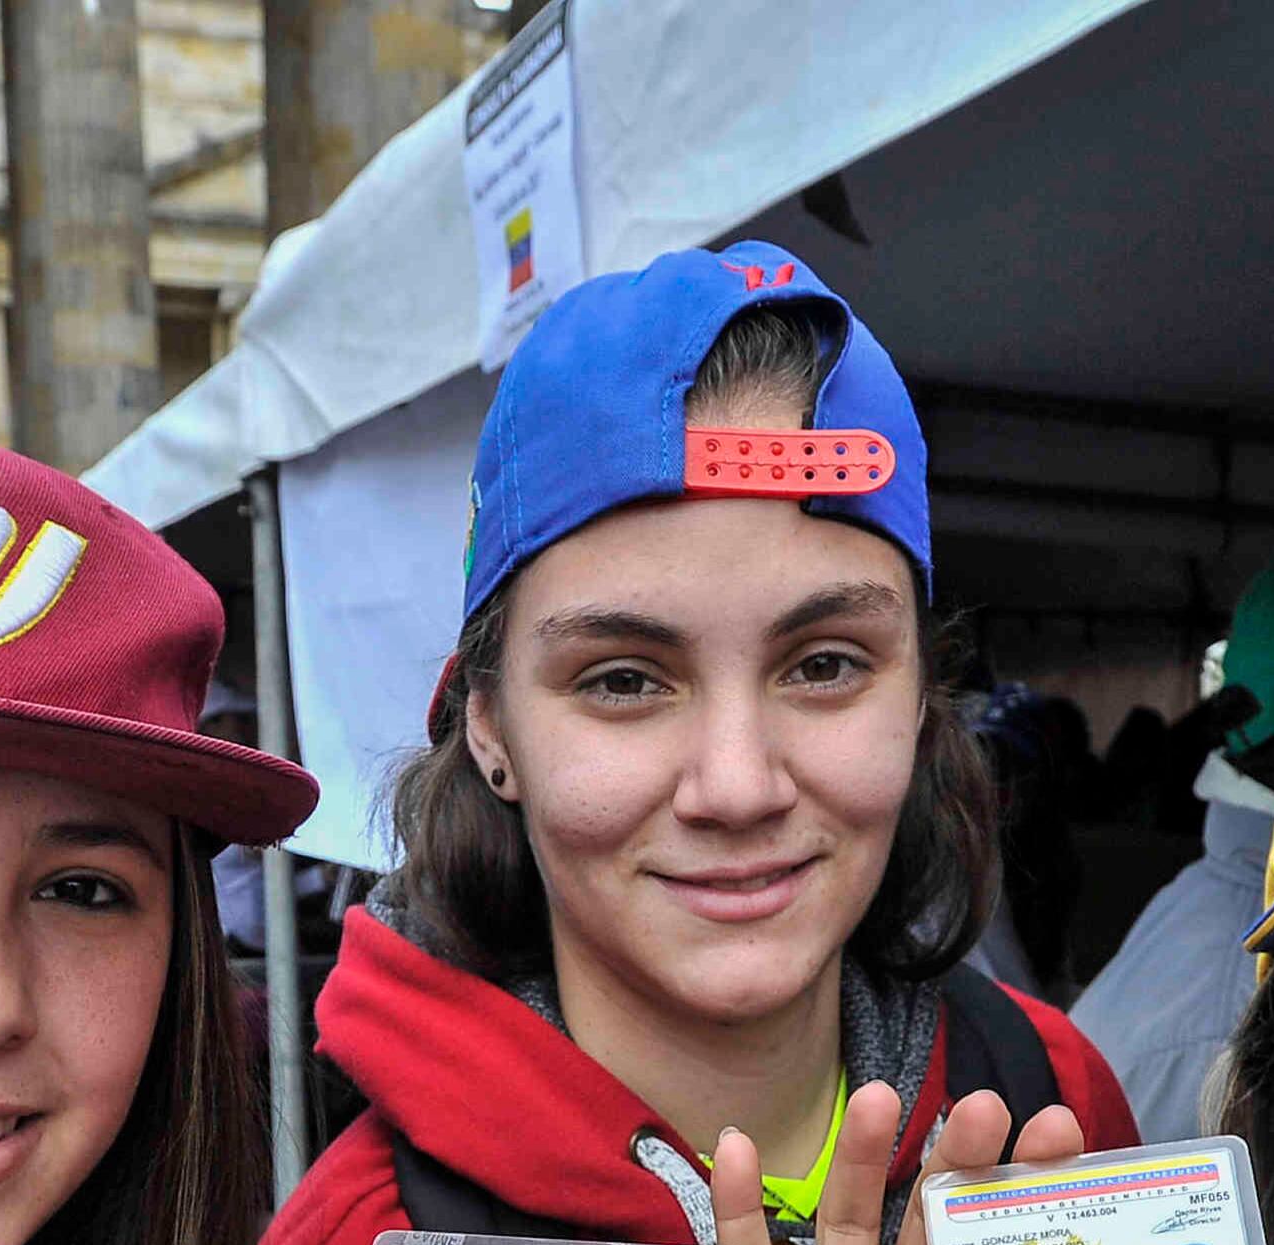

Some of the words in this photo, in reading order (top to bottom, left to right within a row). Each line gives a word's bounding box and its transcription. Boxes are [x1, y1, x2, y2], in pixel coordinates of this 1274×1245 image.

[957, 1189, 1026, 1204] REPUBLICA
[1030, 1177, 1115, 1195] BOLIVARIANA
[1117, 1175, 1133, 1184] DE
[1137, 1166, 1209, 1181] VENEZUELA
[979, 1205, 1047, 1219] CEDULA
[1059, 1200, 1076, 1208] DE
[1089, 1186, 1189, 1204] IDENTIDAD
[1189, 1191, 1231, 1205] MF055
[1046, 1214, 1055, 1223] V
